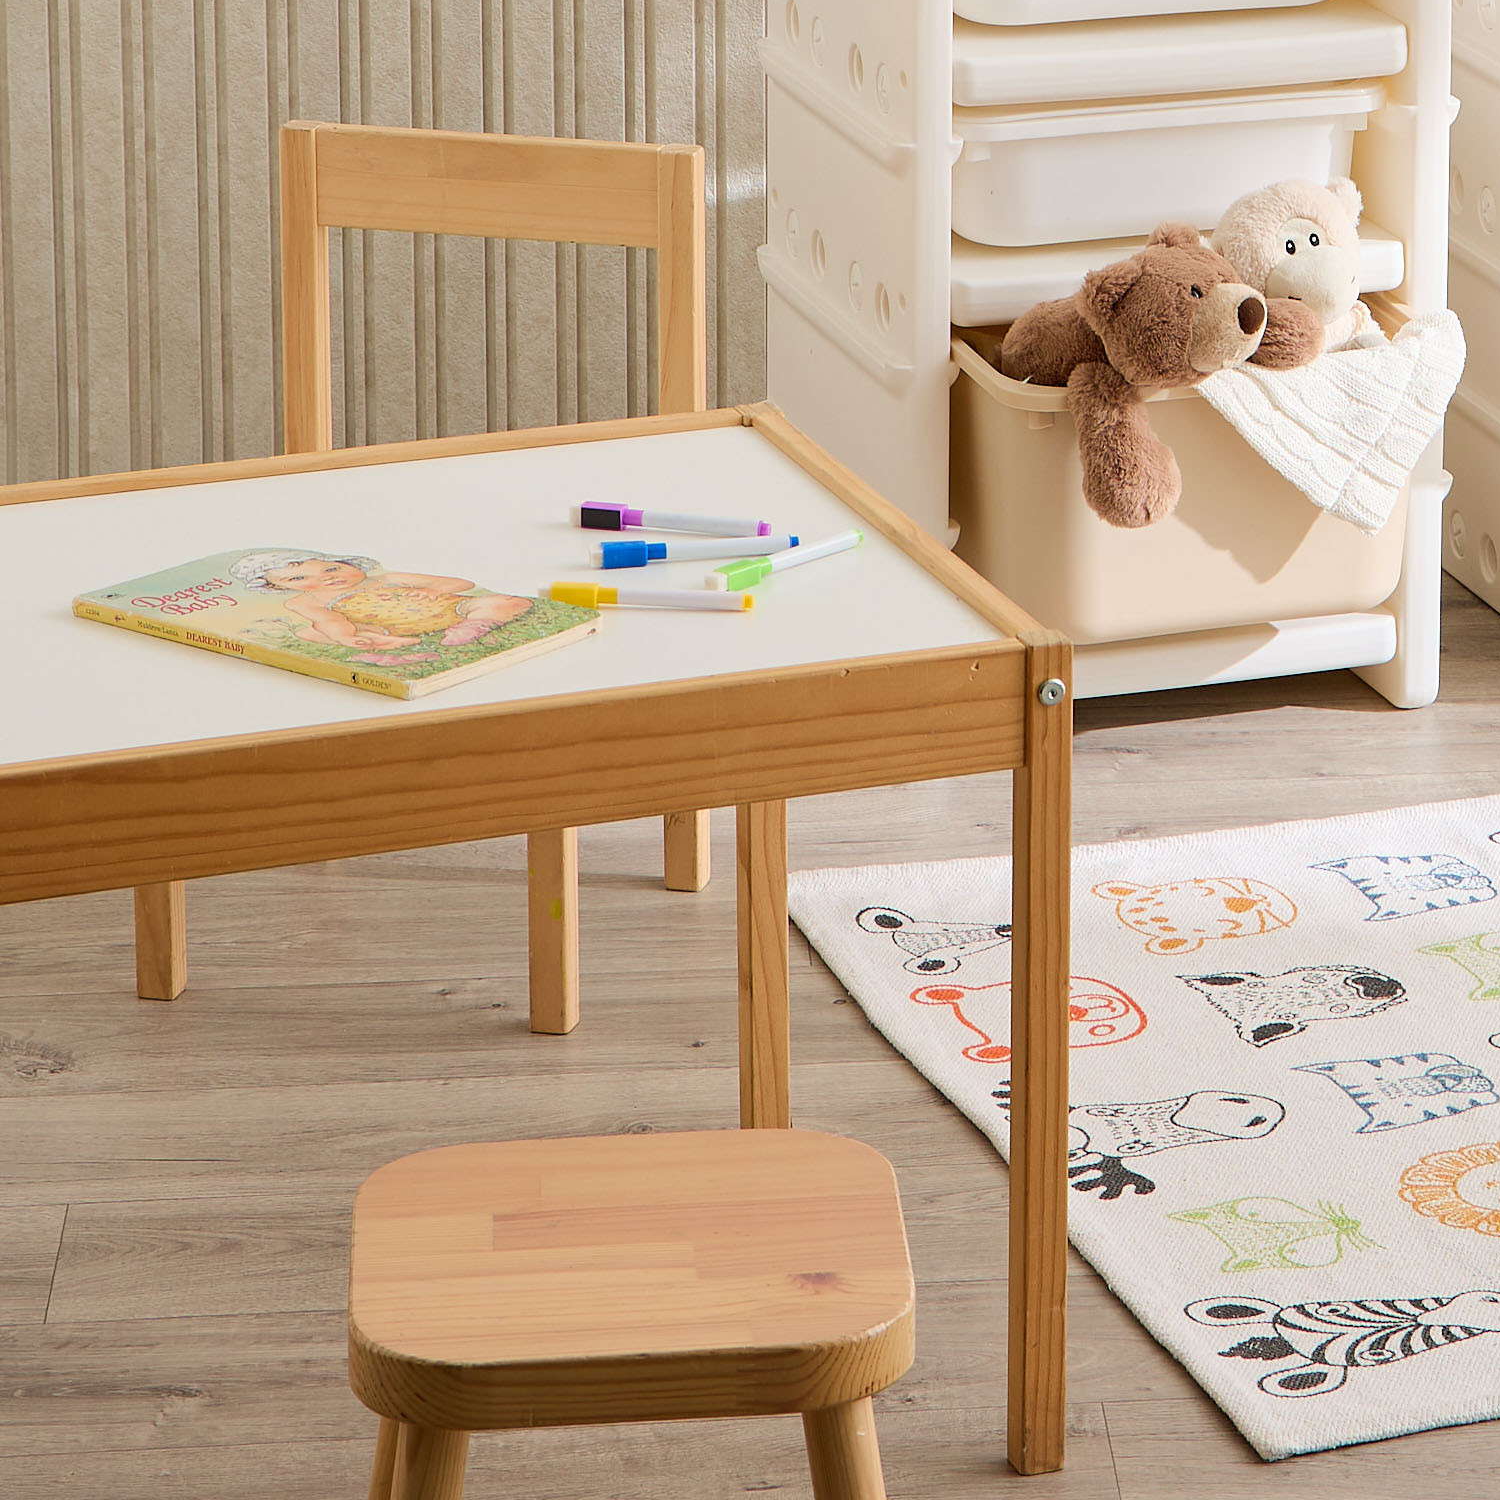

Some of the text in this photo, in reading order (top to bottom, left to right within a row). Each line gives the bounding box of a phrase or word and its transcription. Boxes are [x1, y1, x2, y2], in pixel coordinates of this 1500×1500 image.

[131, 577, 233, 608] Dearest
[160, 595, 238, 616] Baby
[186, 631, 222, 648] DEAREST
[224, 641, 246, 655] BABY
